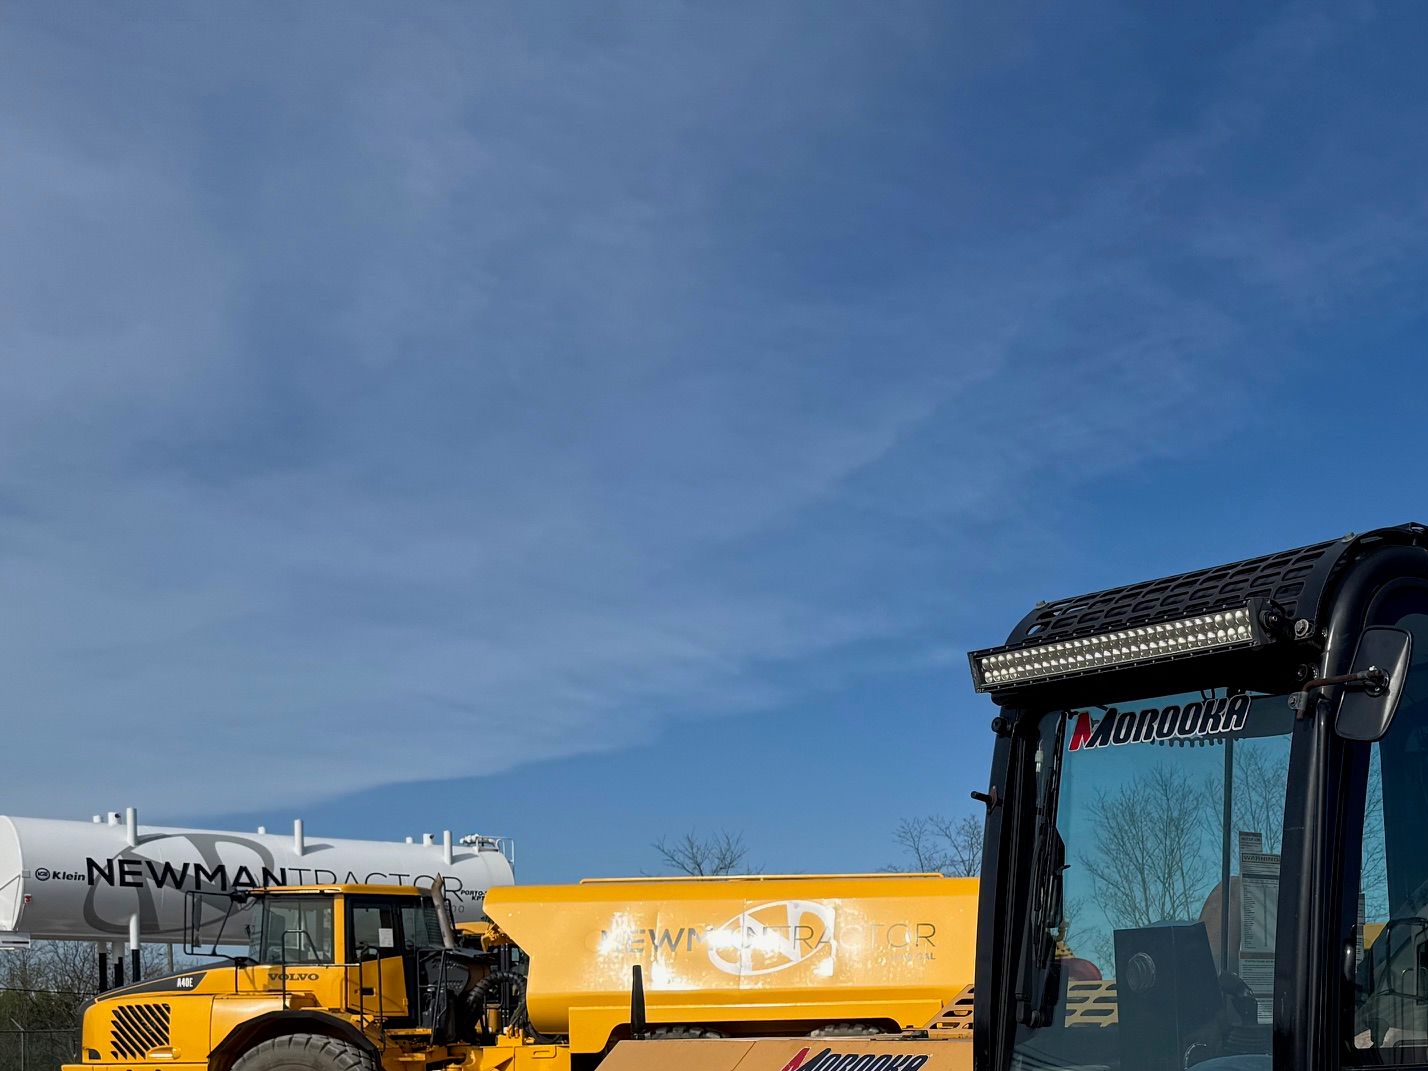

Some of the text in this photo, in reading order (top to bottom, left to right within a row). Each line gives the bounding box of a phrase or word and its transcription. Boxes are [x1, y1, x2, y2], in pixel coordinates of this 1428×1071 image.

[1068, 694, 1251, 752] MOROOKA
[52, 870, 86, 881] Klein
[176, 977, 194, 988] A40E
[268, 973, 319, 981] VOLVO
